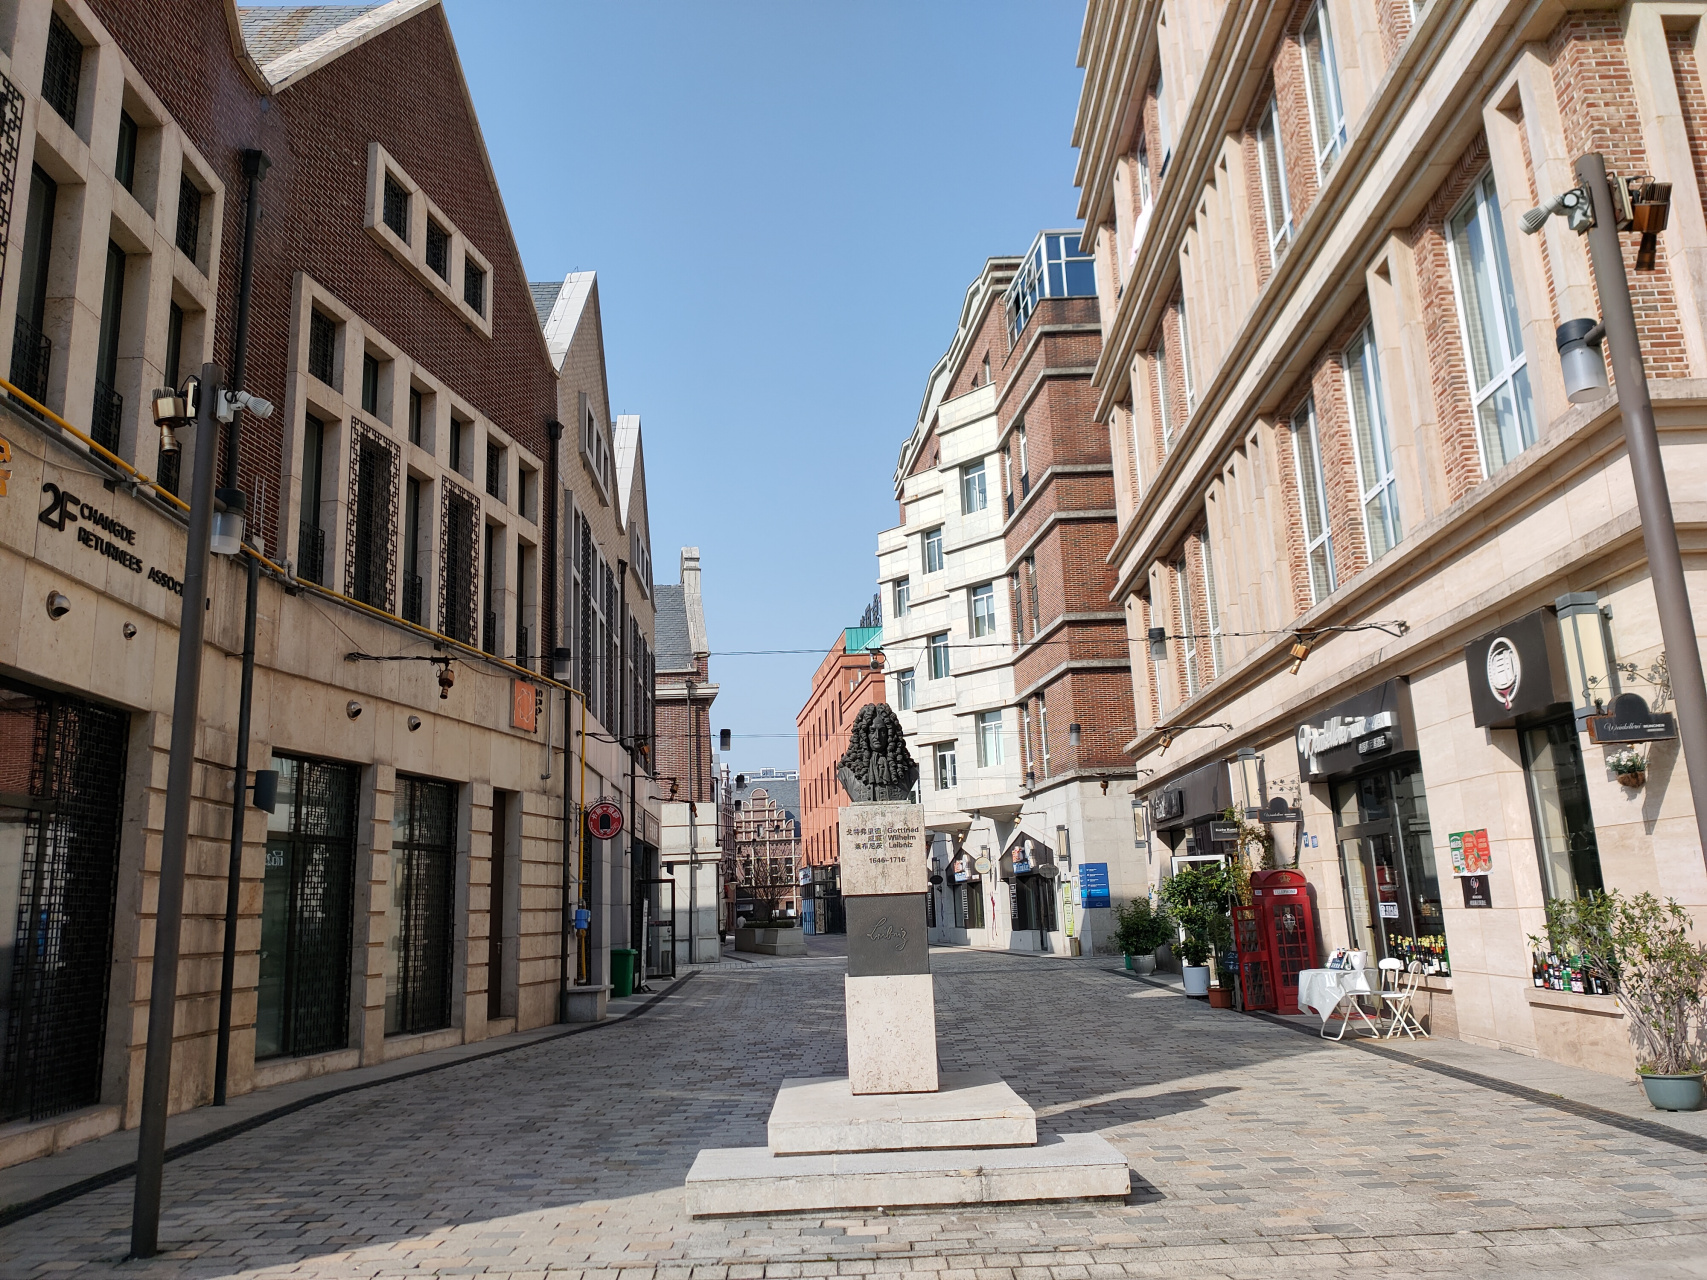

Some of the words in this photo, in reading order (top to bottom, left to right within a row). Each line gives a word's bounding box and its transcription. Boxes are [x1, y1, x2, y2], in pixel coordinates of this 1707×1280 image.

[39, 482, 81, 532] 2F
[80, 503, 137, 546] CHANGDE
[78, 526, 144, 574] RETURNEES
[148, 566, 184, 597] ASSOCI
[888, 841, 914, 849] Leibniz
